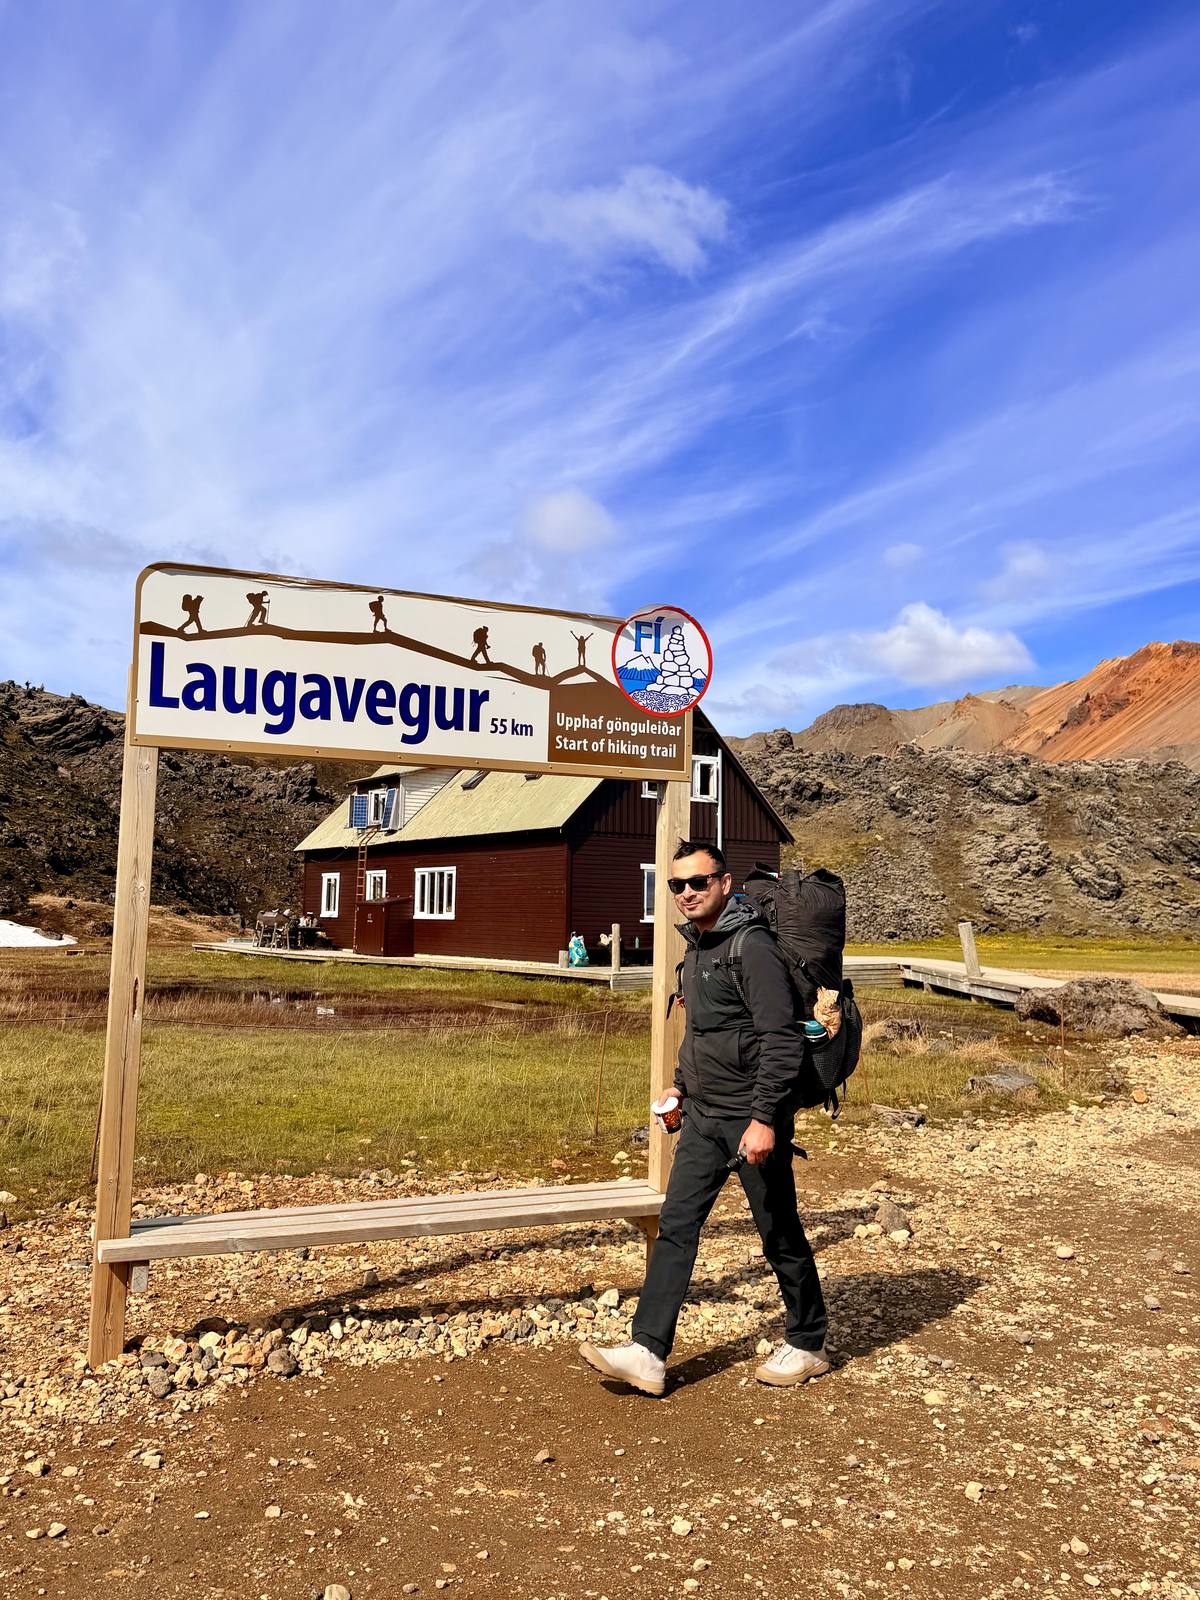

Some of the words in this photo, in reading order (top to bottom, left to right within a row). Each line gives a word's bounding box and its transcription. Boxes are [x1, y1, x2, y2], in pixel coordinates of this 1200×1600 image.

[149, 641, 490, 745] Laugavegur
[490, 717, 508, 735] 55
[511, 718, 534, 737] km
[556, 712, 604, 731] Upphaf
[606, 717, 682, 736] gönguleiðar
[555, 735, 588, 752] Start
[591, 738, 605, 753] of
[607, 740, 647, 759] hiking
[650, 743, 677, 758] trail
